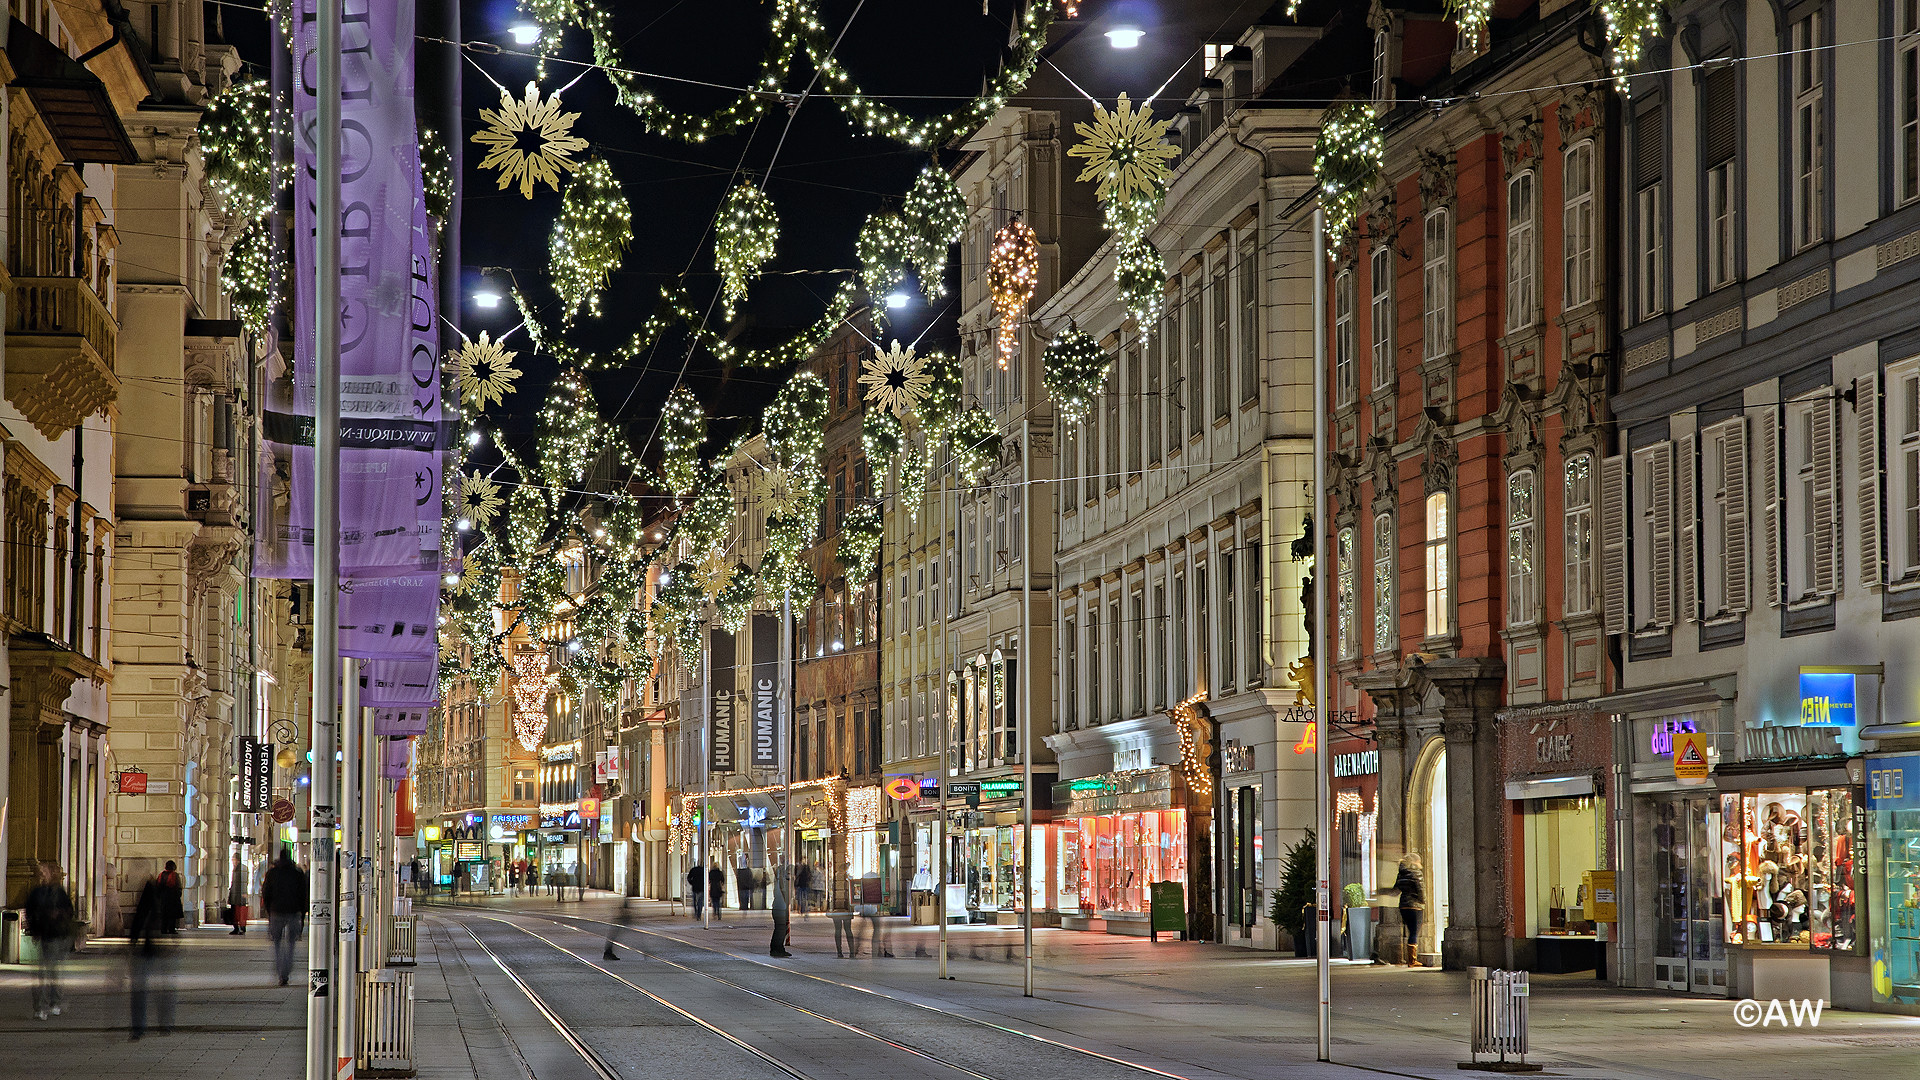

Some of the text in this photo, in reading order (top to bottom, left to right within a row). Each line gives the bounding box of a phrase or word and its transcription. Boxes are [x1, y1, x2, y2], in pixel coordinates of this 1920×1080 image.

[715, 689, 731, 767] HUMANIC
[757, 678, 773, 760] HUMANIC
[259, 744, 269, 808] VERO MODA
[981, 782, 1020, 790] SALAMANDER
